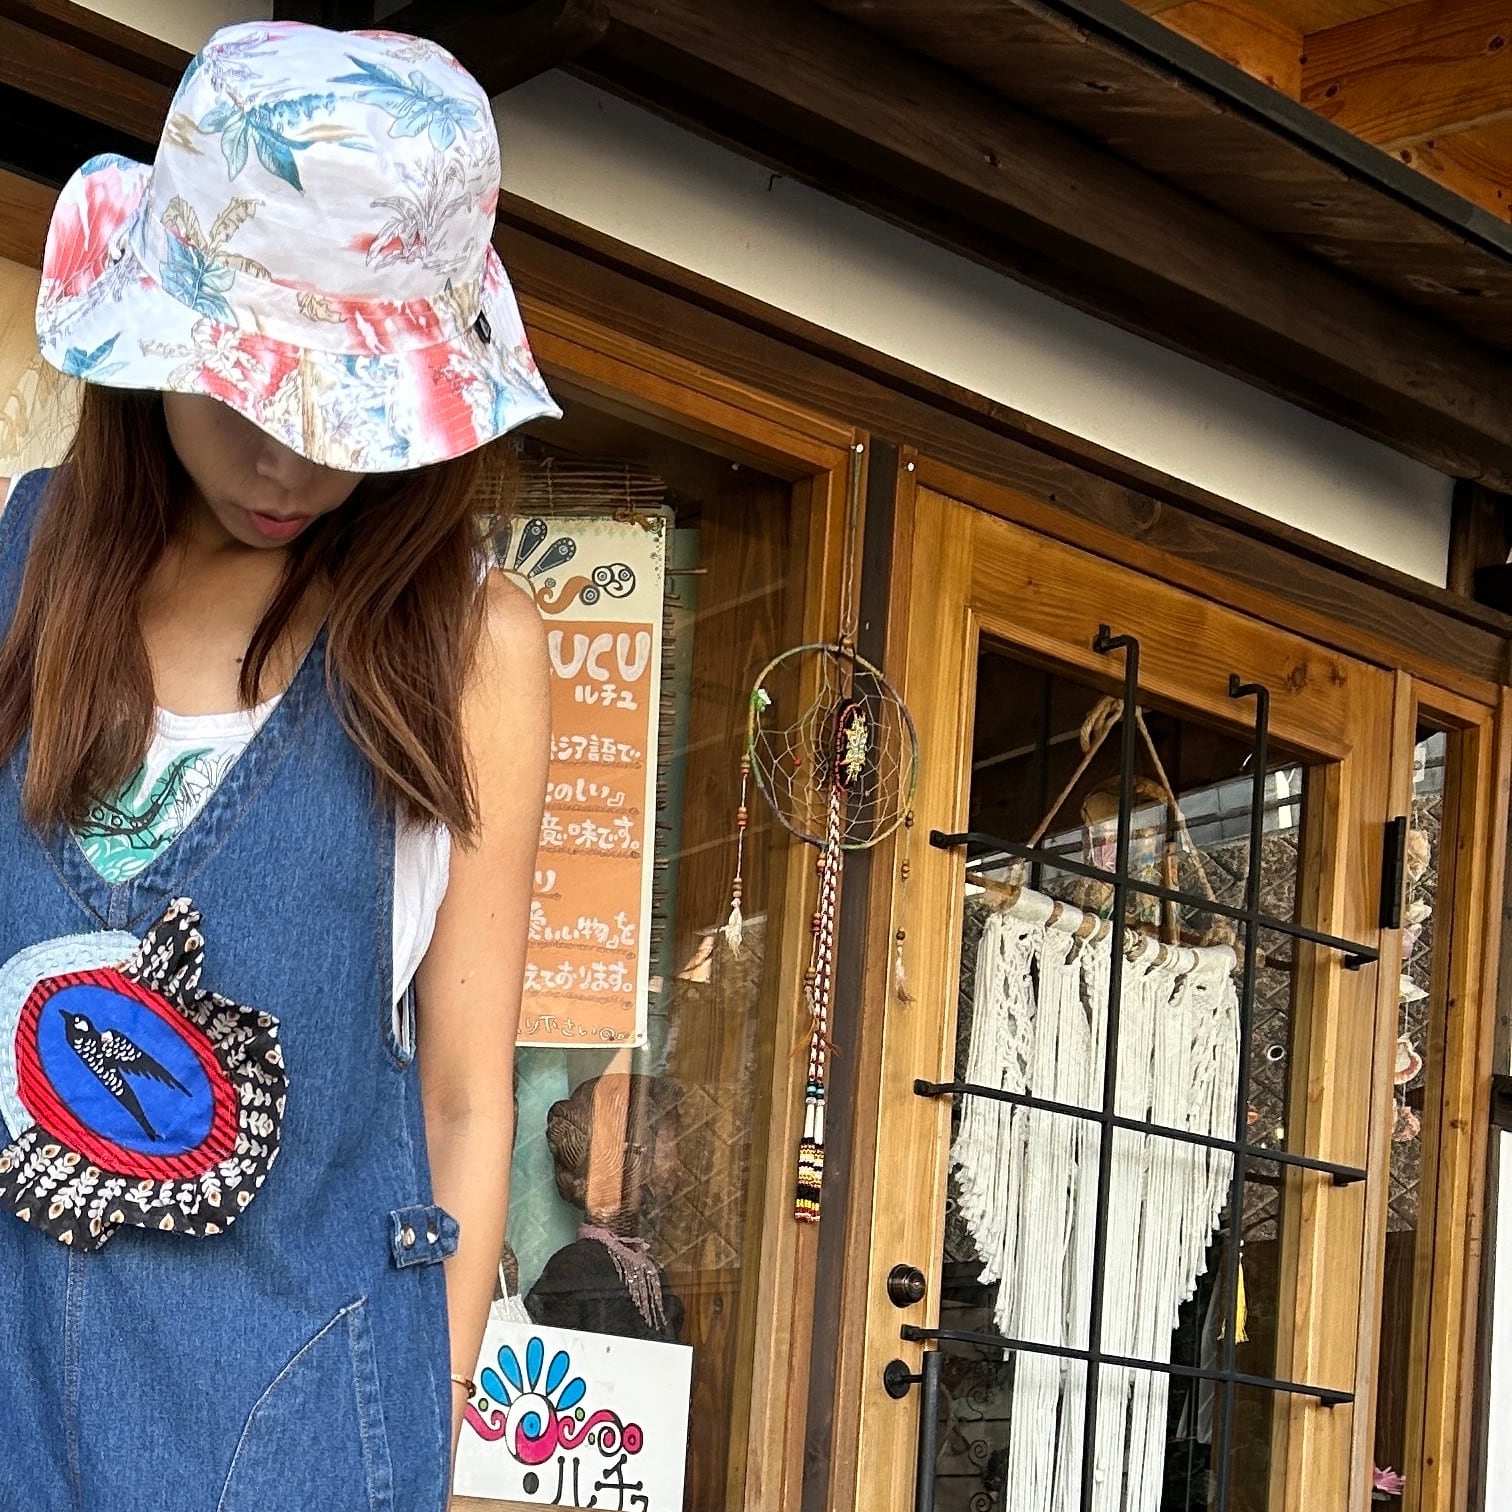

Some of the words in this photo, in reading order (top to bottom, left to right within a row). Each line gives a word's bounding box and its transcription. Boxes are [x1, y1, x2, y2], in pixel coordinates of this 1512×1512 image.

[548, 629, 652, 683] UCU
[574, 683, 638, 711] ルチュ
